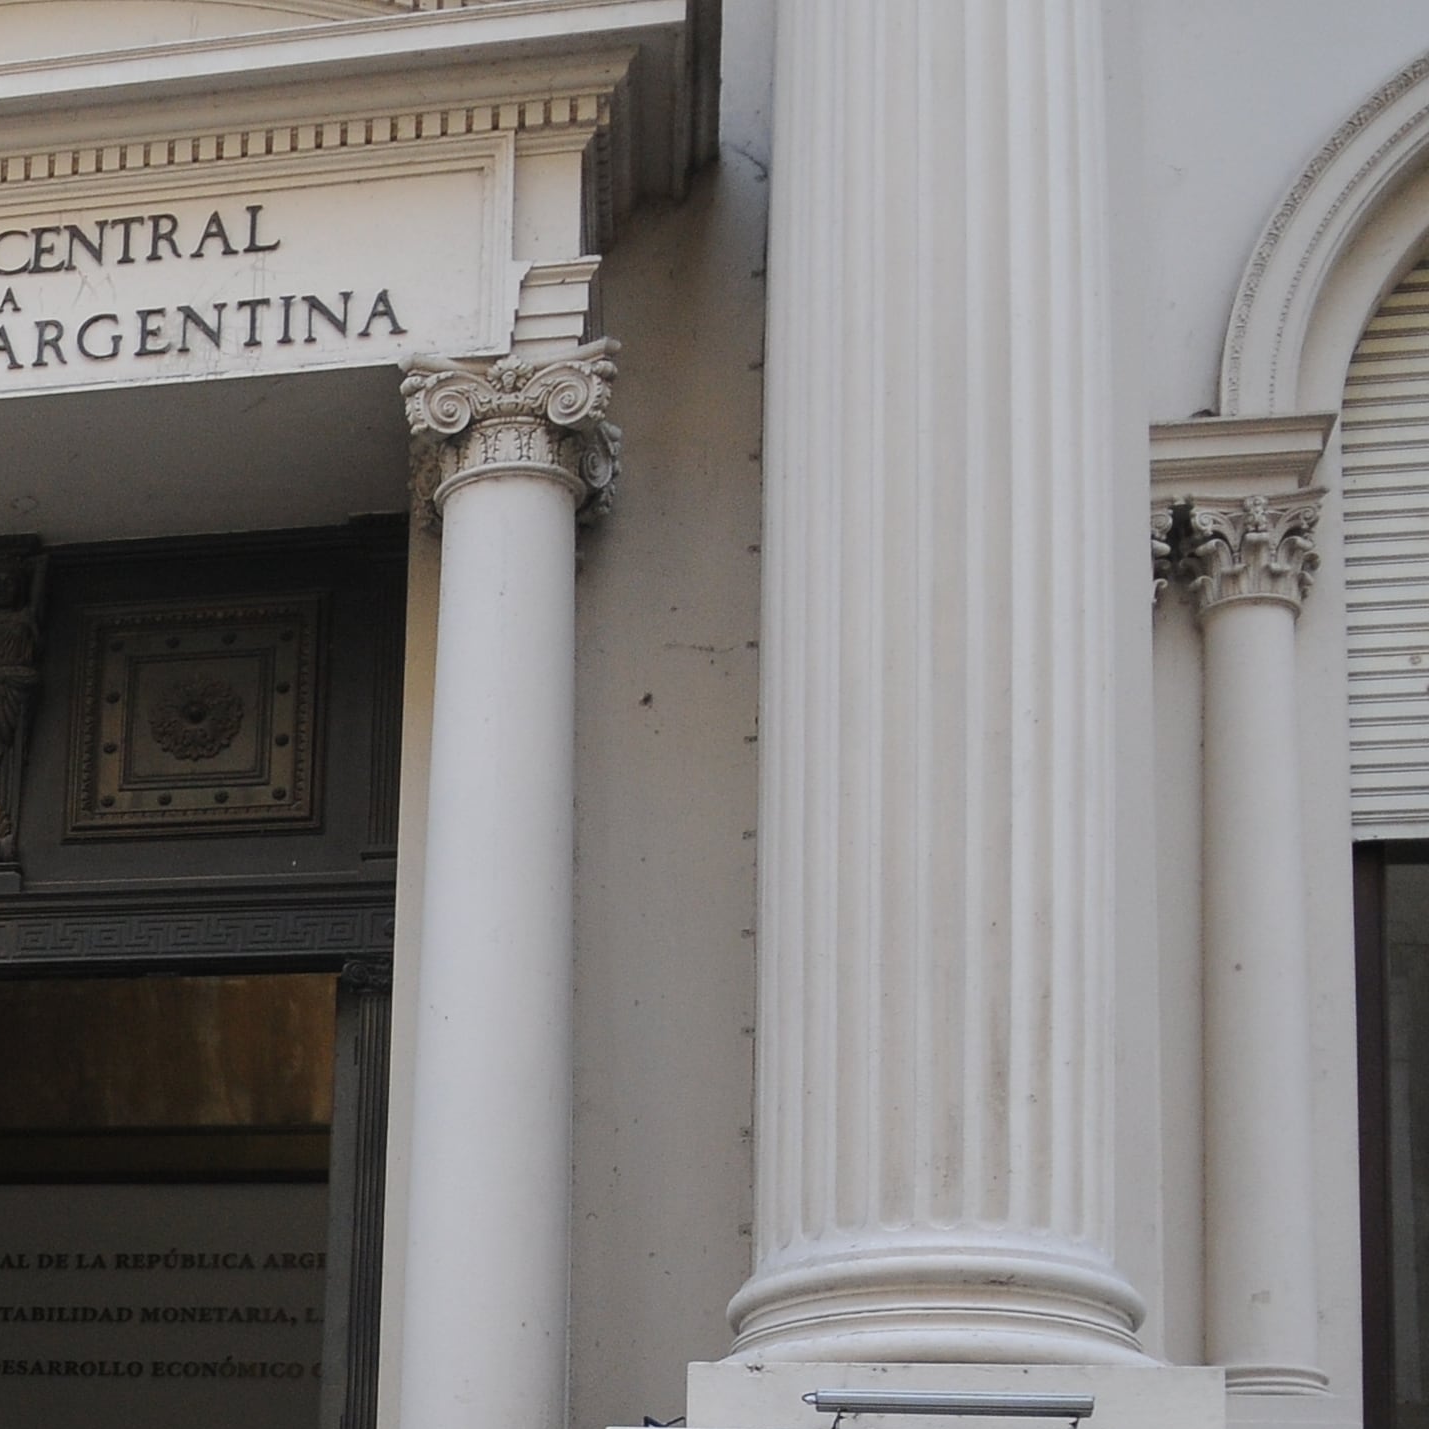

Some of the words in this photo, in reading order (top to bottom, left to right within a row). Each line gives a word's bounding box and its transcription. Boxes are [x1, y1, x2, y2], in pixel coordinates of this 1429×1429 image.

[37, 1253, 69, 1270] DE
[75, 1253, 107, 1270] LA
[115, 1247, 255, 1271] REPÚBLICA
[140, 1306, 298, 1327] MONETARIA,
[151, 1355, 305, 1379] ECONÓMICO
